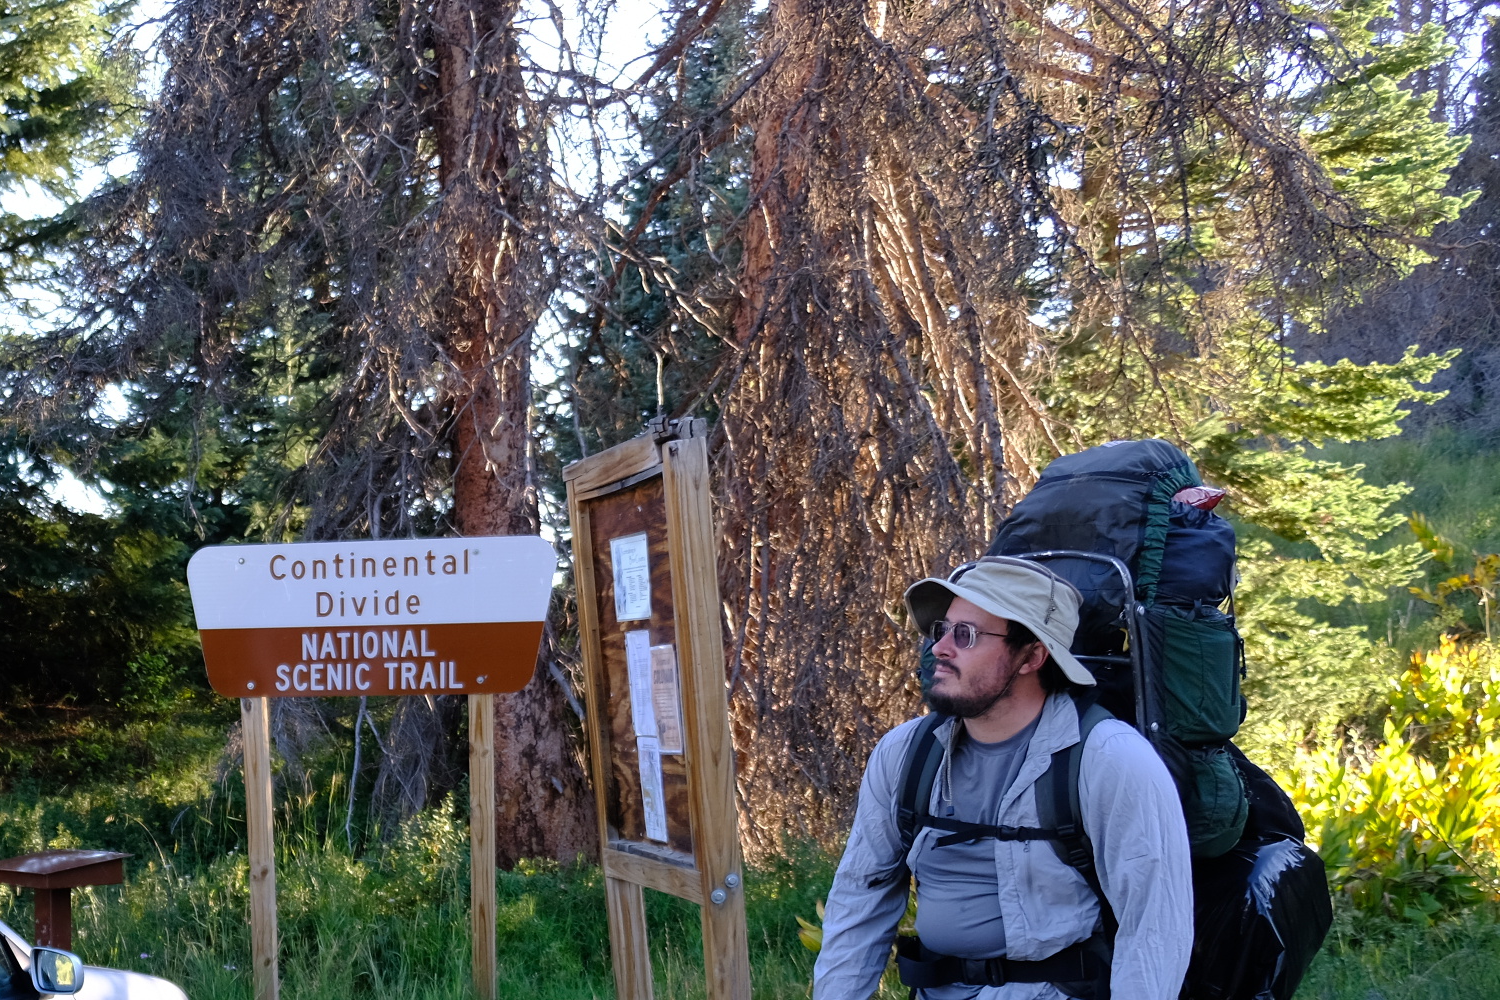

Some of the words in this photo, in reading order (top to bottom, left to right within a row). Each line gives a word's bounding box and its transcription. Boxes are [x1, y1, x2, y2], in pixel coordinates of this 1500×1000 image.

[269, 549, 470, 581] Continental
[316, 590, 421, 618] Divide
[301, 629, 435, 661] NATIONAL
[276, 663, 370, 692] SCENIC
[384, 661, 463, 691] TRAIL
